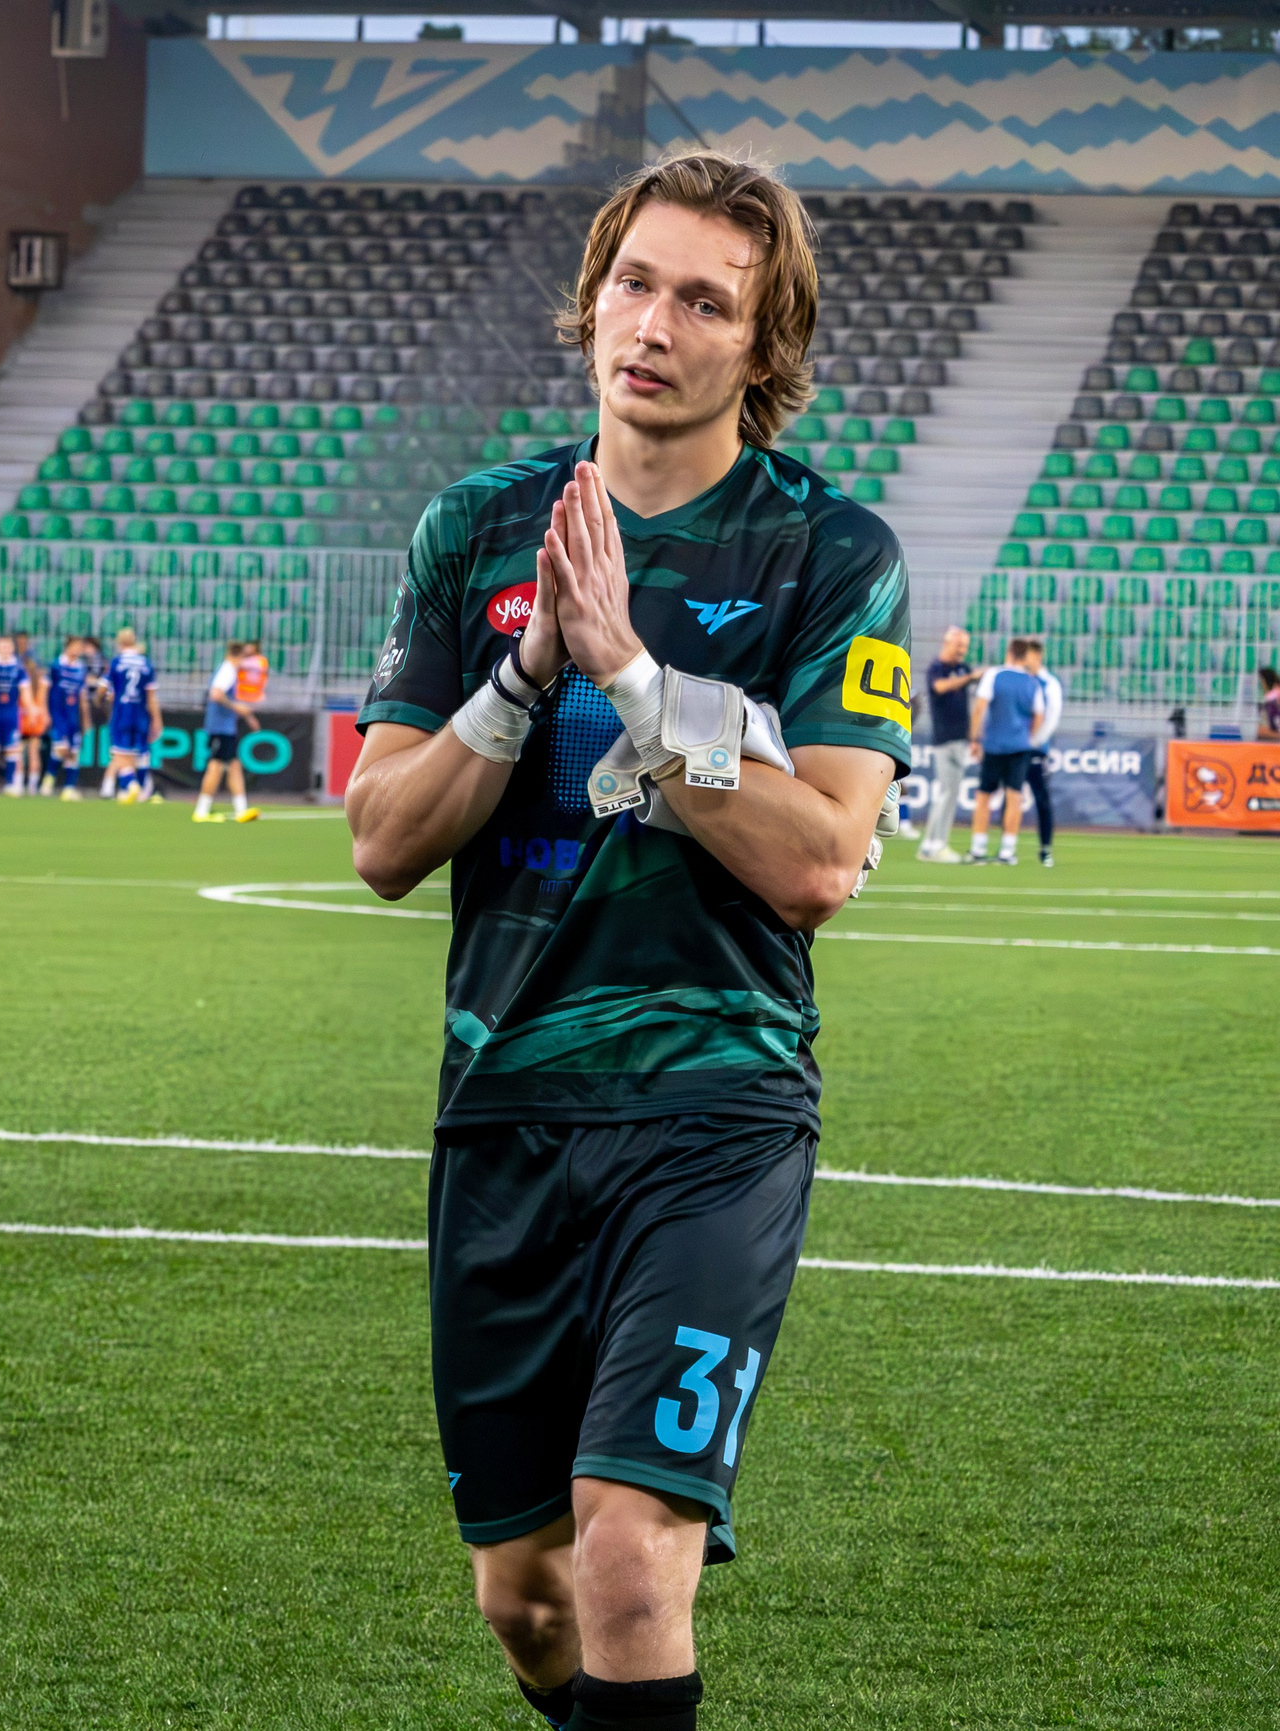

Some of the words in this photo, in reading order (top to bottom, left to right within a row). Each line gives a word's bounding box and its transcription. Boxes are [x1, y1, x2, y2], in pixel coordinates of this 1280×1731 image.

[495, 596, 532, 624] Уве
[1042, 749, 1141, 774] ОССИЯ
[690, 775, 735, 788] ELITE
[597, 796, 641, 815] ELITE
[654, 1325, 761, 1468] 31
